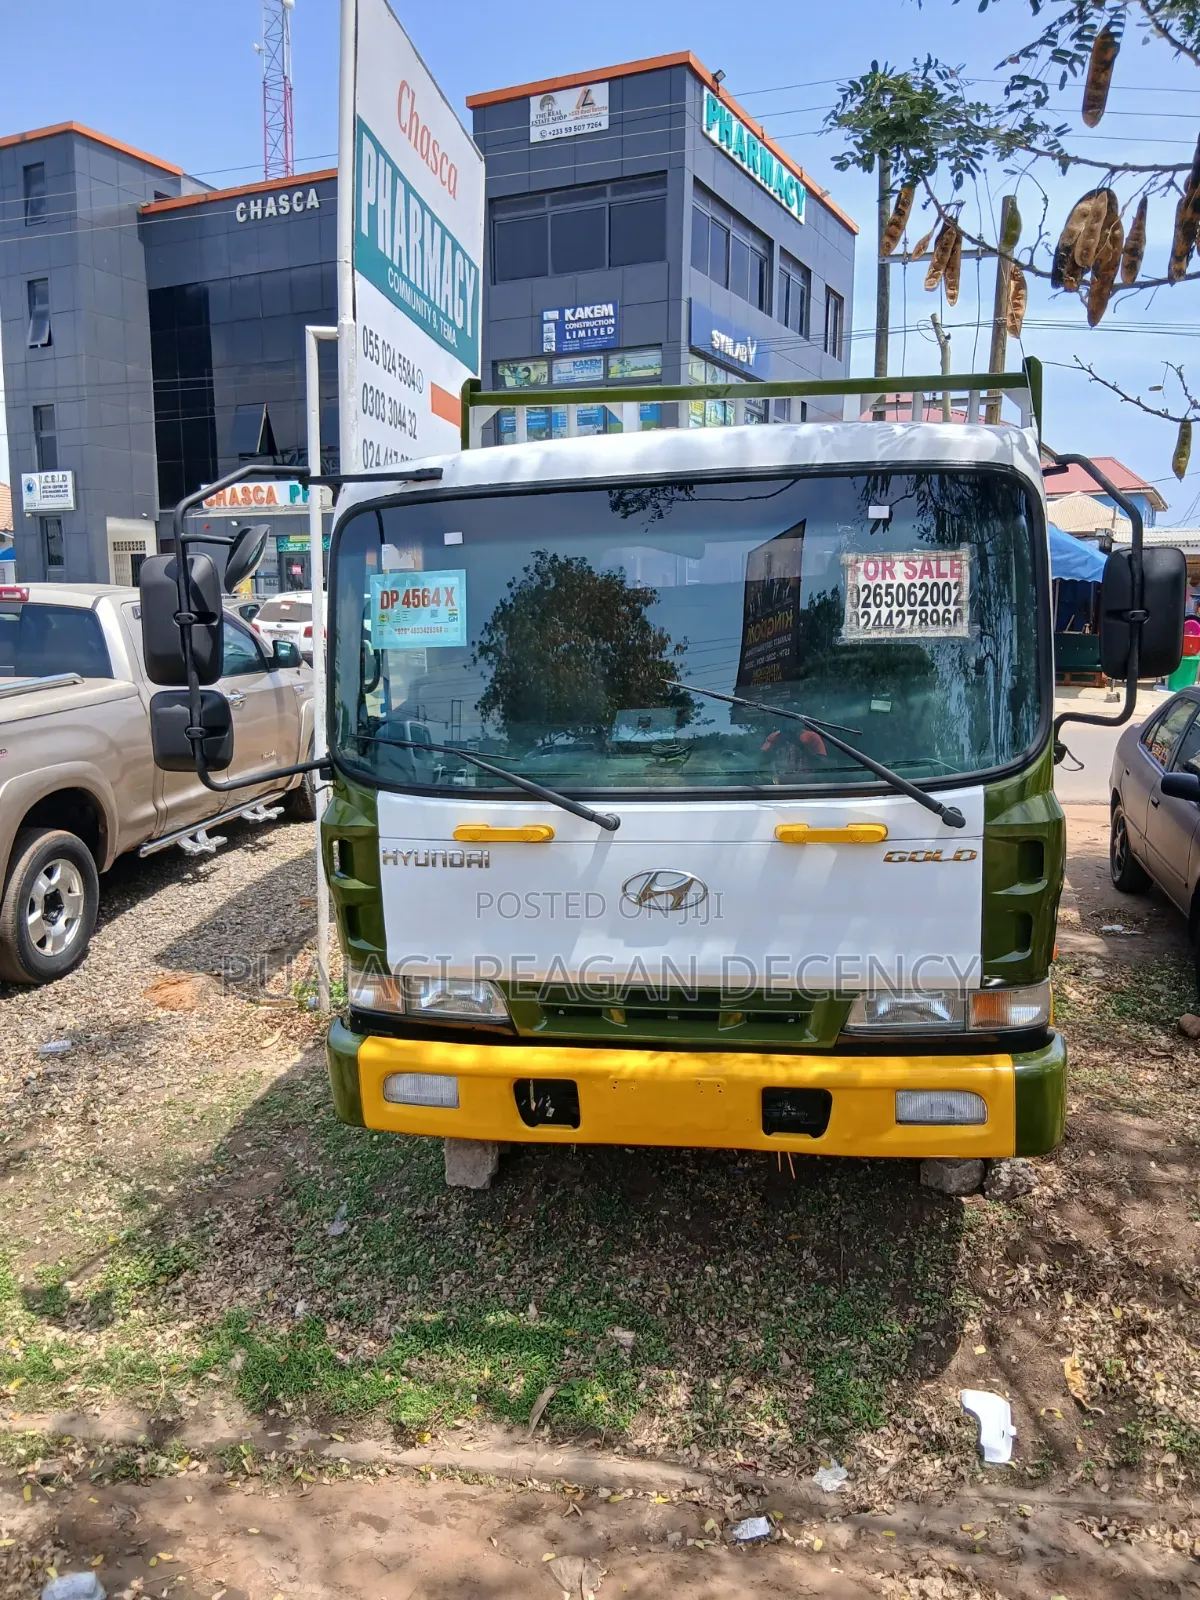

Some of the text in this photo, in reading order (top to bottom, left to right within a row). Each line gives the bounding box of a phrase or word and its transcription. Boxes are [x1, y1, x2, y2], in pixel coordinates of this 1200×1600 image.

[531, 117, 550, 126] ESTATE
[551, 114, 567, 122] SHOP
[548, 121, 602, 136] +233 59 507 7264
[397, 79, 458, 201] Chasca
[706, 93, 807, 216] PHARMACY
[236, 188, 320, 223] CHASCA
[361, 132, 475, 337] PHARMACY
[388, 267, 432, 323] COMMUNITY
[565, 303, 614, 321] KAKEM
[565, 318, 615, 330] CONSTRUCTION
[566, 326, 614, 340] LIMITED
[362, 324, 416, 391] 055 024 5584
[573, 358, 602, 368] KAKEM
[362, 382, 418, 440] 0303 3044 32
[903, 555, 962, 580] SALE
[380, 586, 456, 609] DP 4564 X
[381, 848, 491, 869] HYUNDAI
[883, 849, 978, 863] GOLD
